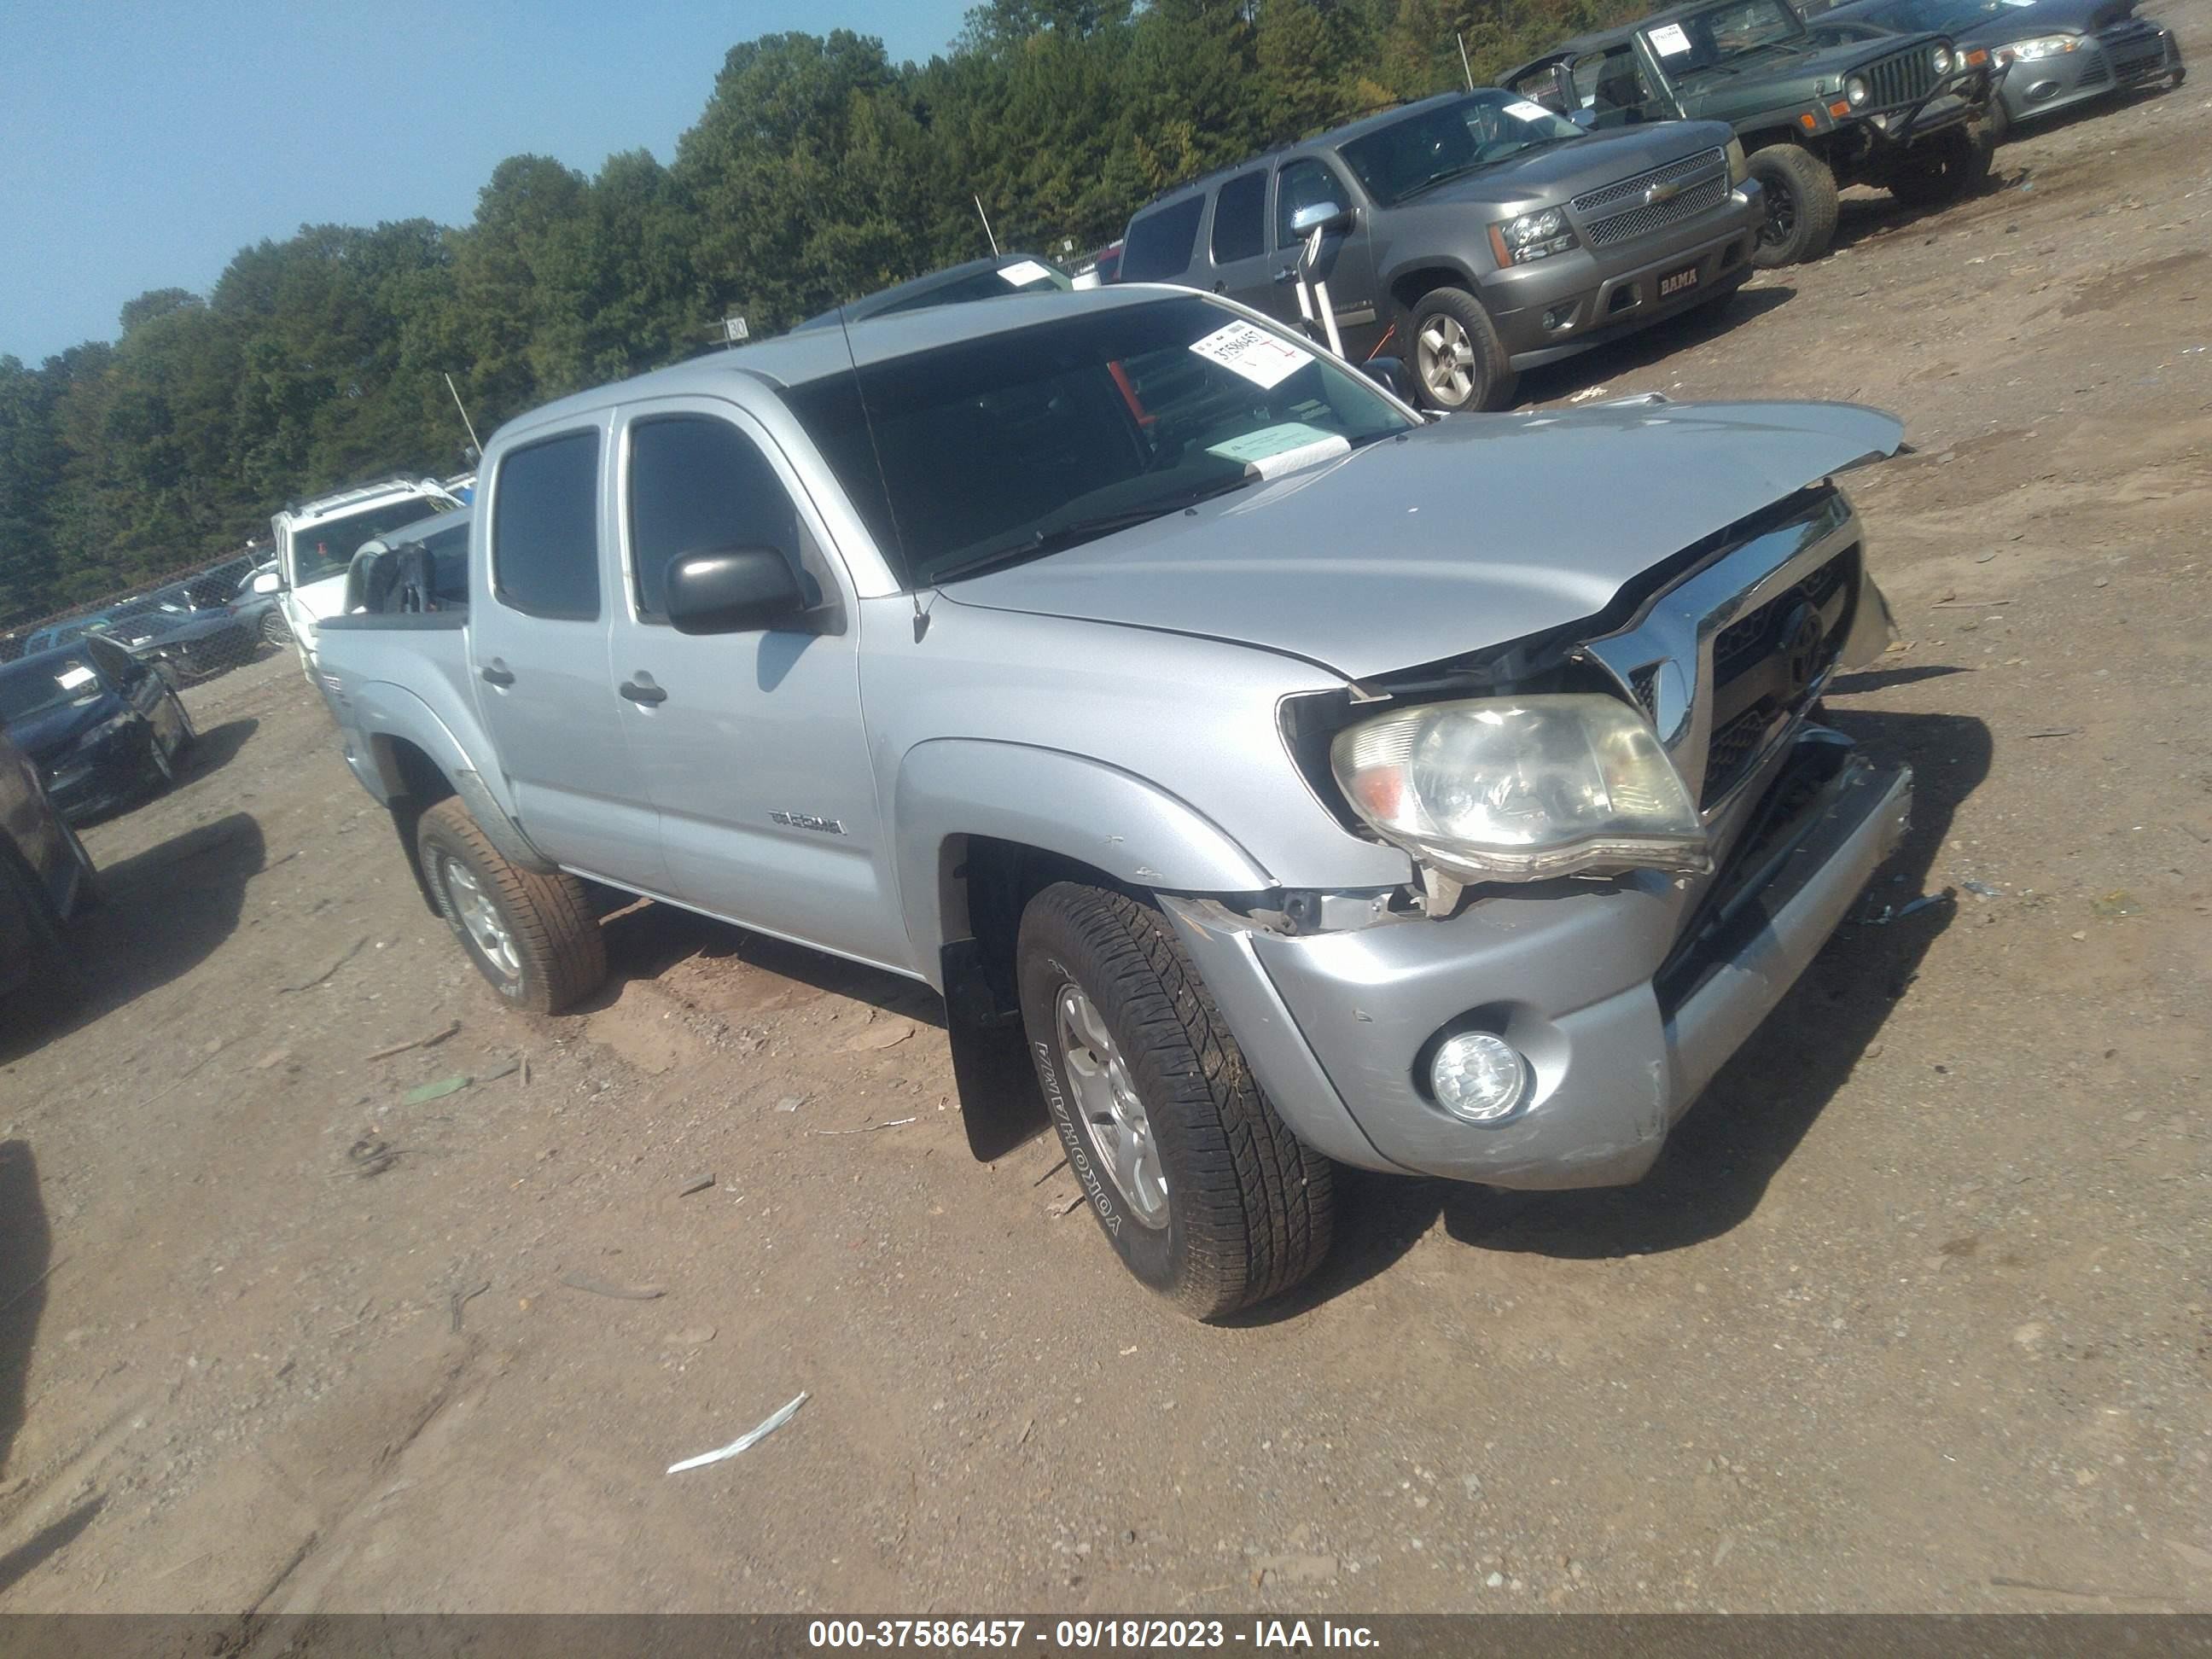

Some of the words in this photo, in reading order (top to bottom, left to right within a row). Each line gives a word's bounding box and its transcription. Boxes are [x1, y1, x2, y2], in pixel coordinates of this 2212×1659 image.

[1661, 267, 1697, 295] BAMA
[1214, 329, 1263, 361] 37586457
[1034, 1040, 1122, 1237] YOKOHAMA
